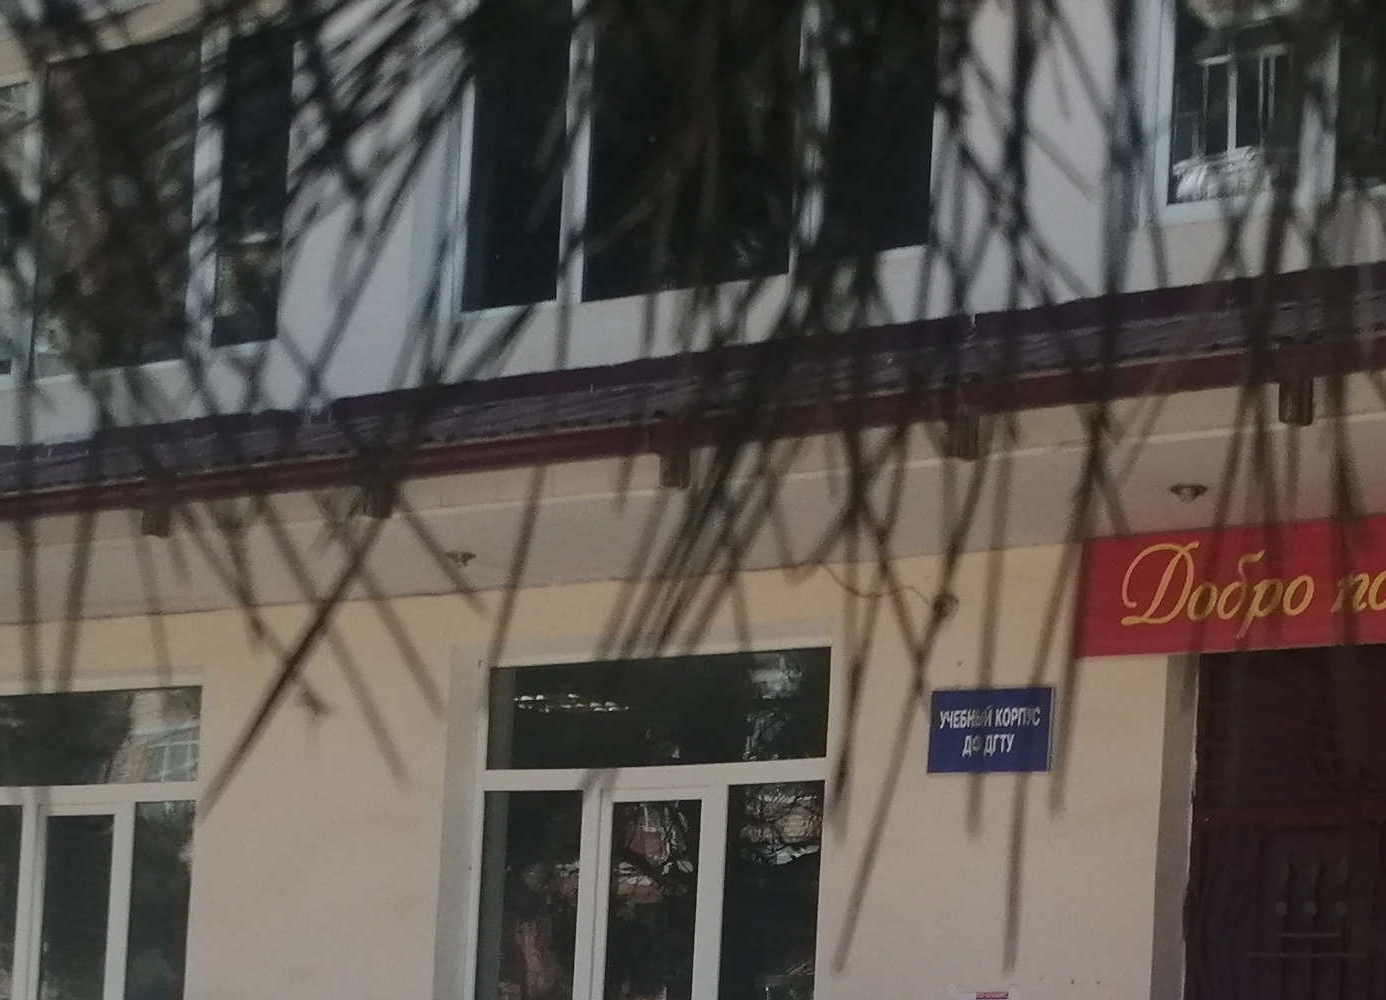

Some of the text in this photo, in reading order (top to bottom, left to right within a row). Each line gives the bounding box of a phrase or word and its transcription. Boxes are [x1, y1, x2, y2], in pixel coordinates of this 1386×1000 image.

[1121, 541, 1315, 639] Добро
[995, 706, 1041, 727] КОРПУС
[983, 733, 1015, 757] ДГТУ
